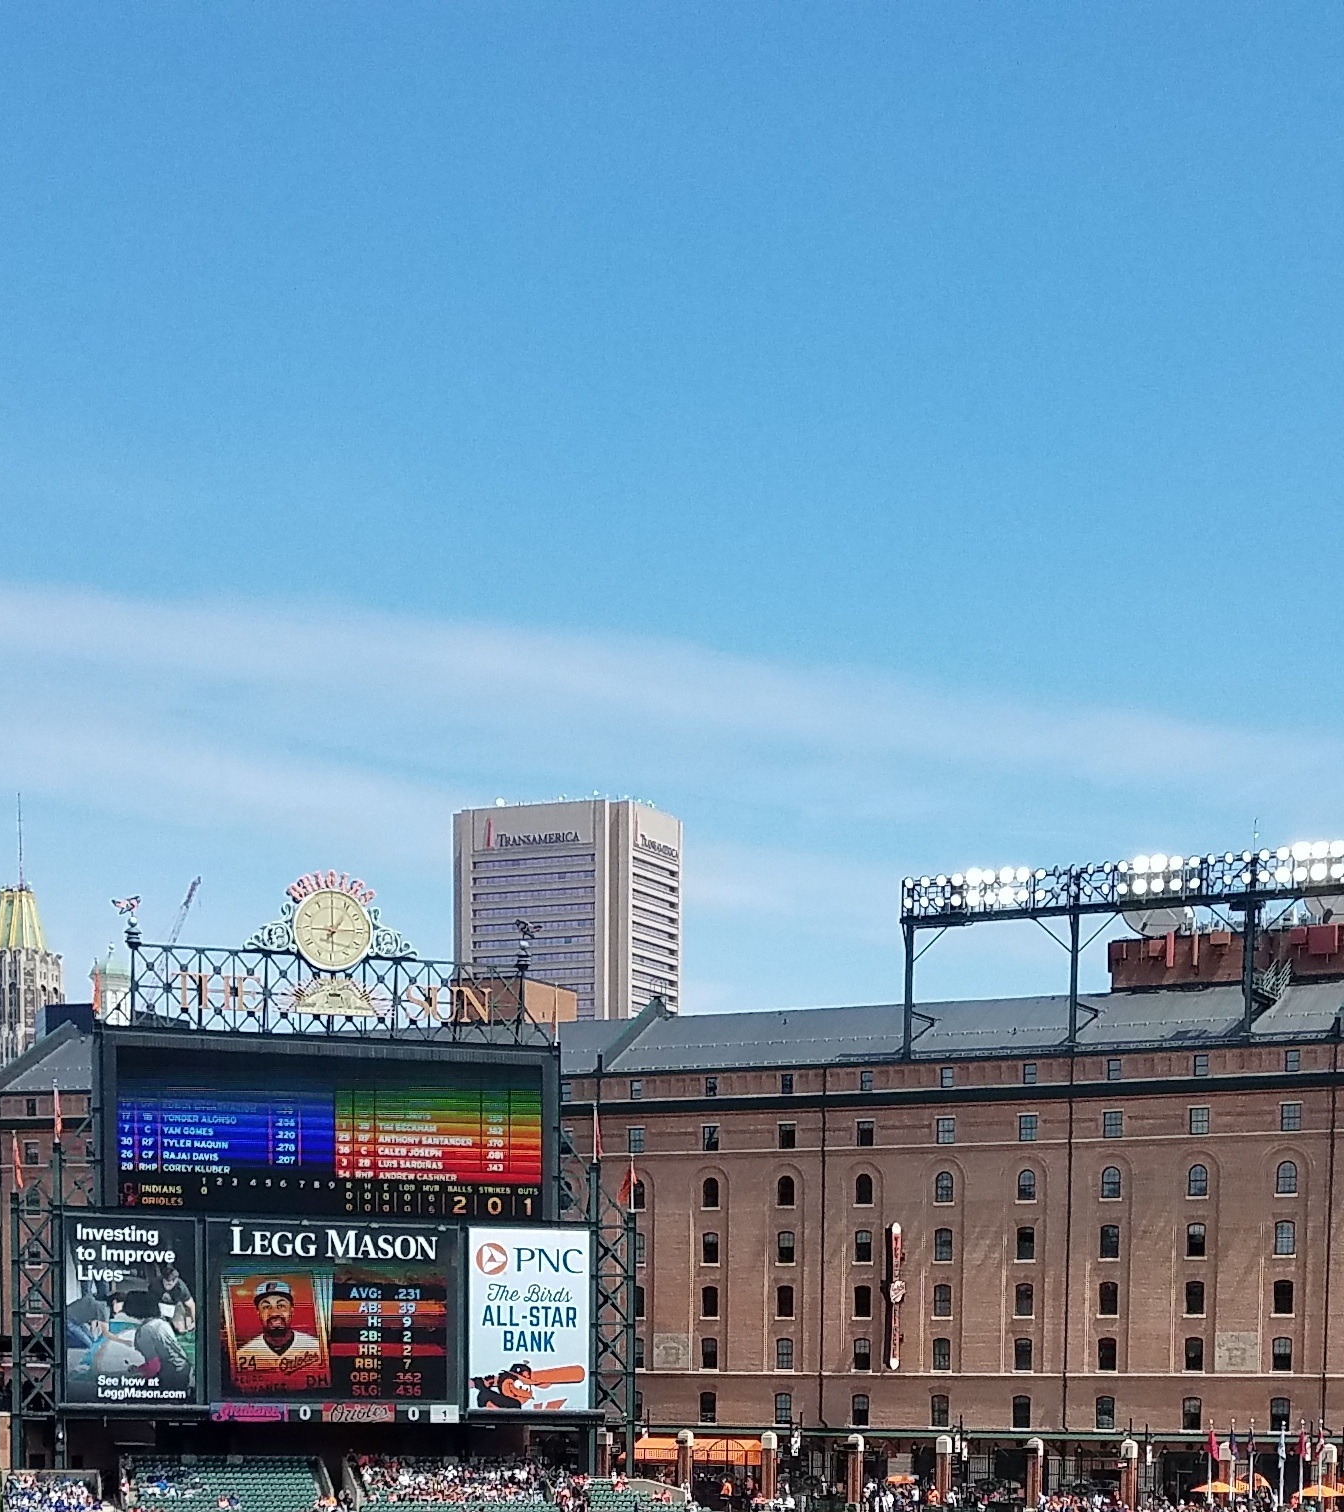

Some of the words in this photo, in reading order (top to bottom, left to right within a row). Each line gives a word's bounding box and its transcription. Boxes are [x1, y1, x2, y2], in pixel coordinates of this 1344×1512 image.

[497, 831, 580, 848] TRANSAMERICA
[171, 971, 264, 1013] THE
[405, 984, 491, 1024] SUN
[163, 1126, 182, 1135] YAN
[183, 1127, 214, 1136] GOMES
[163, 1138, 192, 1148] TYLER
[193, 1140, 229, 1149] NAQUIN
[378, 1136, 420, 1145] ANTHONY
[142, 1150, 154, 1158] CF
[163, 1151, 191, 1160] RAJAI
[192, 1153, 219, 1161] DAVIS
[378, 1148, 407, 1156] CALEB
[408, 1149, 442, 1158] JOSEPH
[163, 1164, 192, 1173] COREY
[194, 1165, 230, 1174] KLUBER
[378, 1160, 398, 1168] LUIS
[378, 1172, 415, 1181] ANDREW
[416, 1173, 457, 1182] CASHNER
[141, 1185, 182, 1194] INDIANS
[447, 1185, 472, 1193] BALLS
[479, 1186, 511, 1195] STRIKES
[141, 1197, 183, 1206] ORIOLES
[453, 1196, 467, 1214] 2
[487, 1197, 502, 1215] 0
[524, 1198, 532, 1216] 1
[76, 1223, 159, 1244] Investing
[230, 1226, 317, 1257] LEGG
[325, 1229, 438, 1261] MASON
[76, 1248, 96, 1261] to
[101, 1247, 176, 1266] Improve
[513, 1247, 584, 1274] PNC
[350, 1288, 382, 1299] AVG:
[394, 1288, 420, 1300] .231
[487, 1283, 520, 1301] The
[524, 1284, 573, 1303] Birds
[358, 1303, 382, 1313] AB:
[398, 1303, 416, 1314] 39
[367, 1316, 382, 1327] H:
[402, 1317, 412, 1327] 9
[482, 1304, 577, 1328] ALL-STAR
[402, 1331, 412, 1342] 2
[503, 1330, 556, 1353] BANK
[359, 1345, 382, 1356] HR:
[402, 1346, 412, 1356] 2
[355, 1358, 382, 1369] RBI:
[403, 1359, 411, 1369] 7
[97, 1376, 119, 1387] See
[121, 1376, 146, 1386] how
[148, 1377, 159, 1387] at
[306, 1374, 329, 1387] DH
[97, 1387, 186, 1400] LeggMason.com
[352, 1386, 382, 1396] SLG:
[299, 1405, 311, 1421] 0
[330, 1403, 388, 1423] Orioles
[408, 1406, 419, 1421] 0
